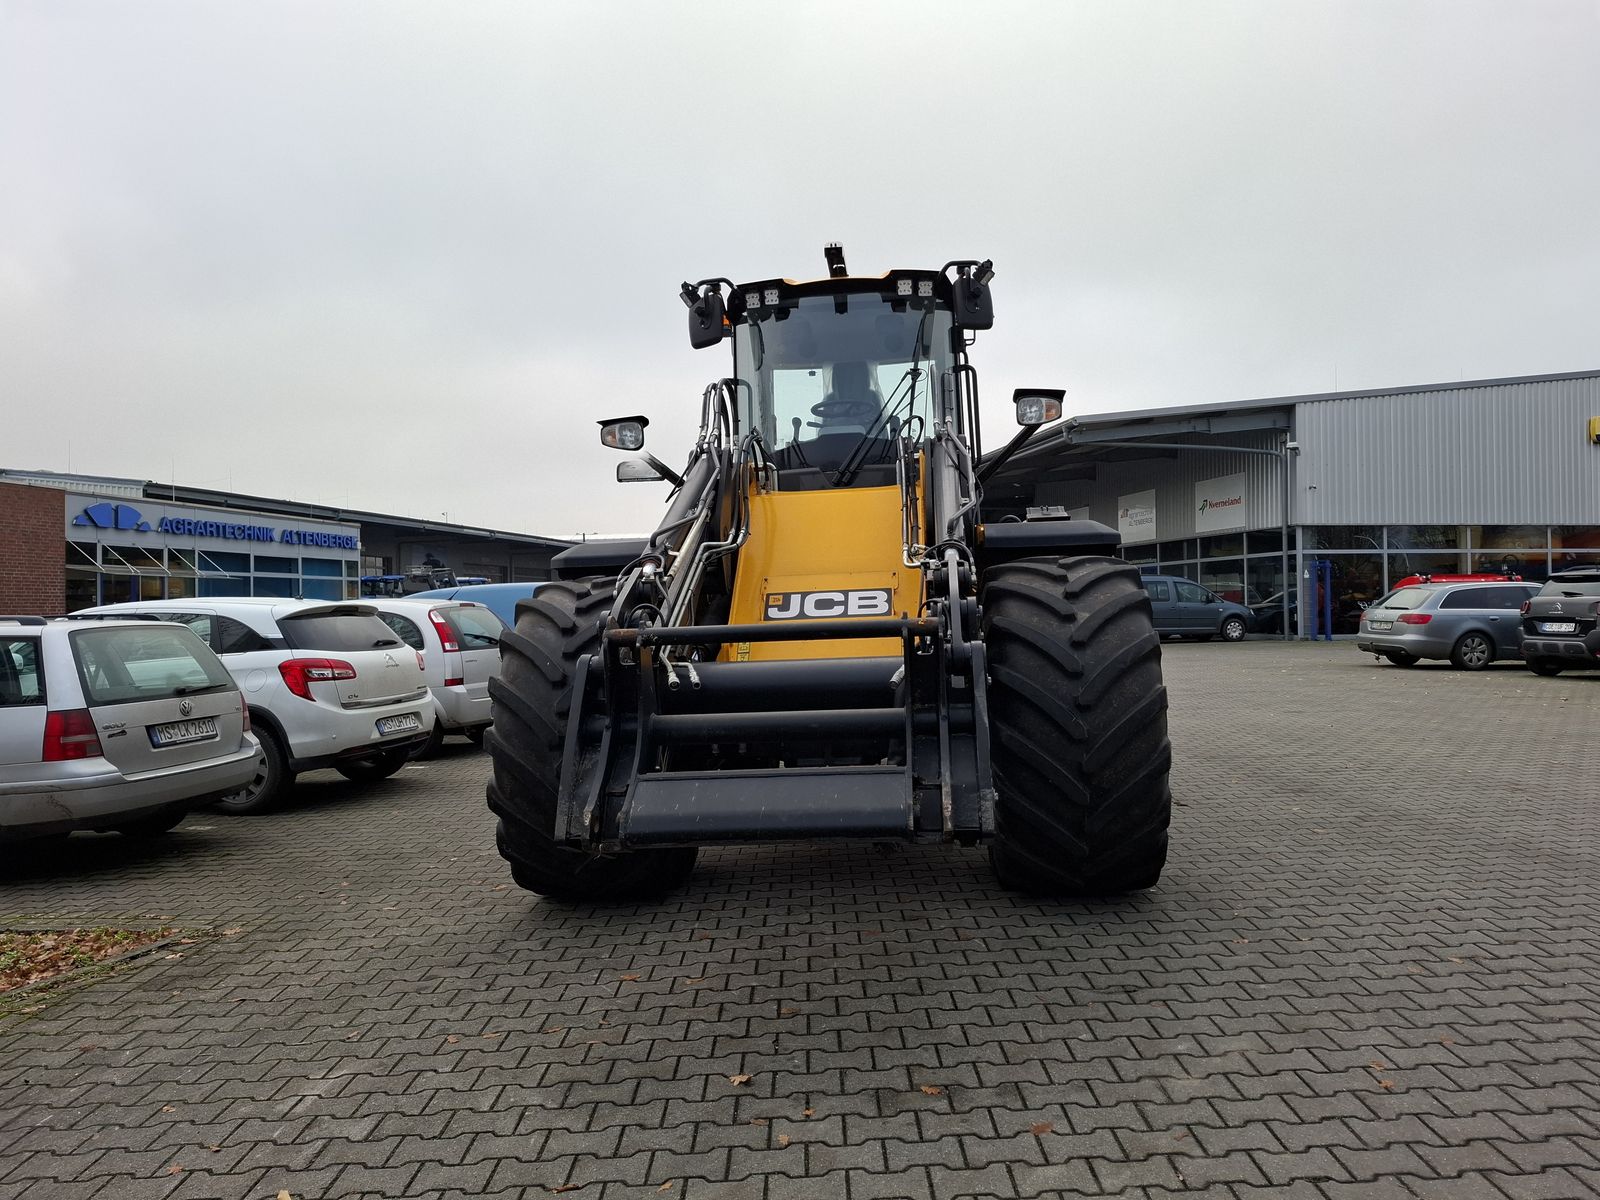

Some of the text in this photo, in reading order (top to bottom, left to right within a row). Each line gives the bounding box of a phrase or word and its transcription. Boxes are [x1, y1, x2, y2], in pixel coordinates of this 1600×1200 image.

[1208, 496, 1241, 510] Kverneland
[160, 516, 358, 550] AGRARTECHNIK ALTENBERGE
[767, 590, 889, 619] JCB
[158, 719, 215, 741] MS LK 2610
